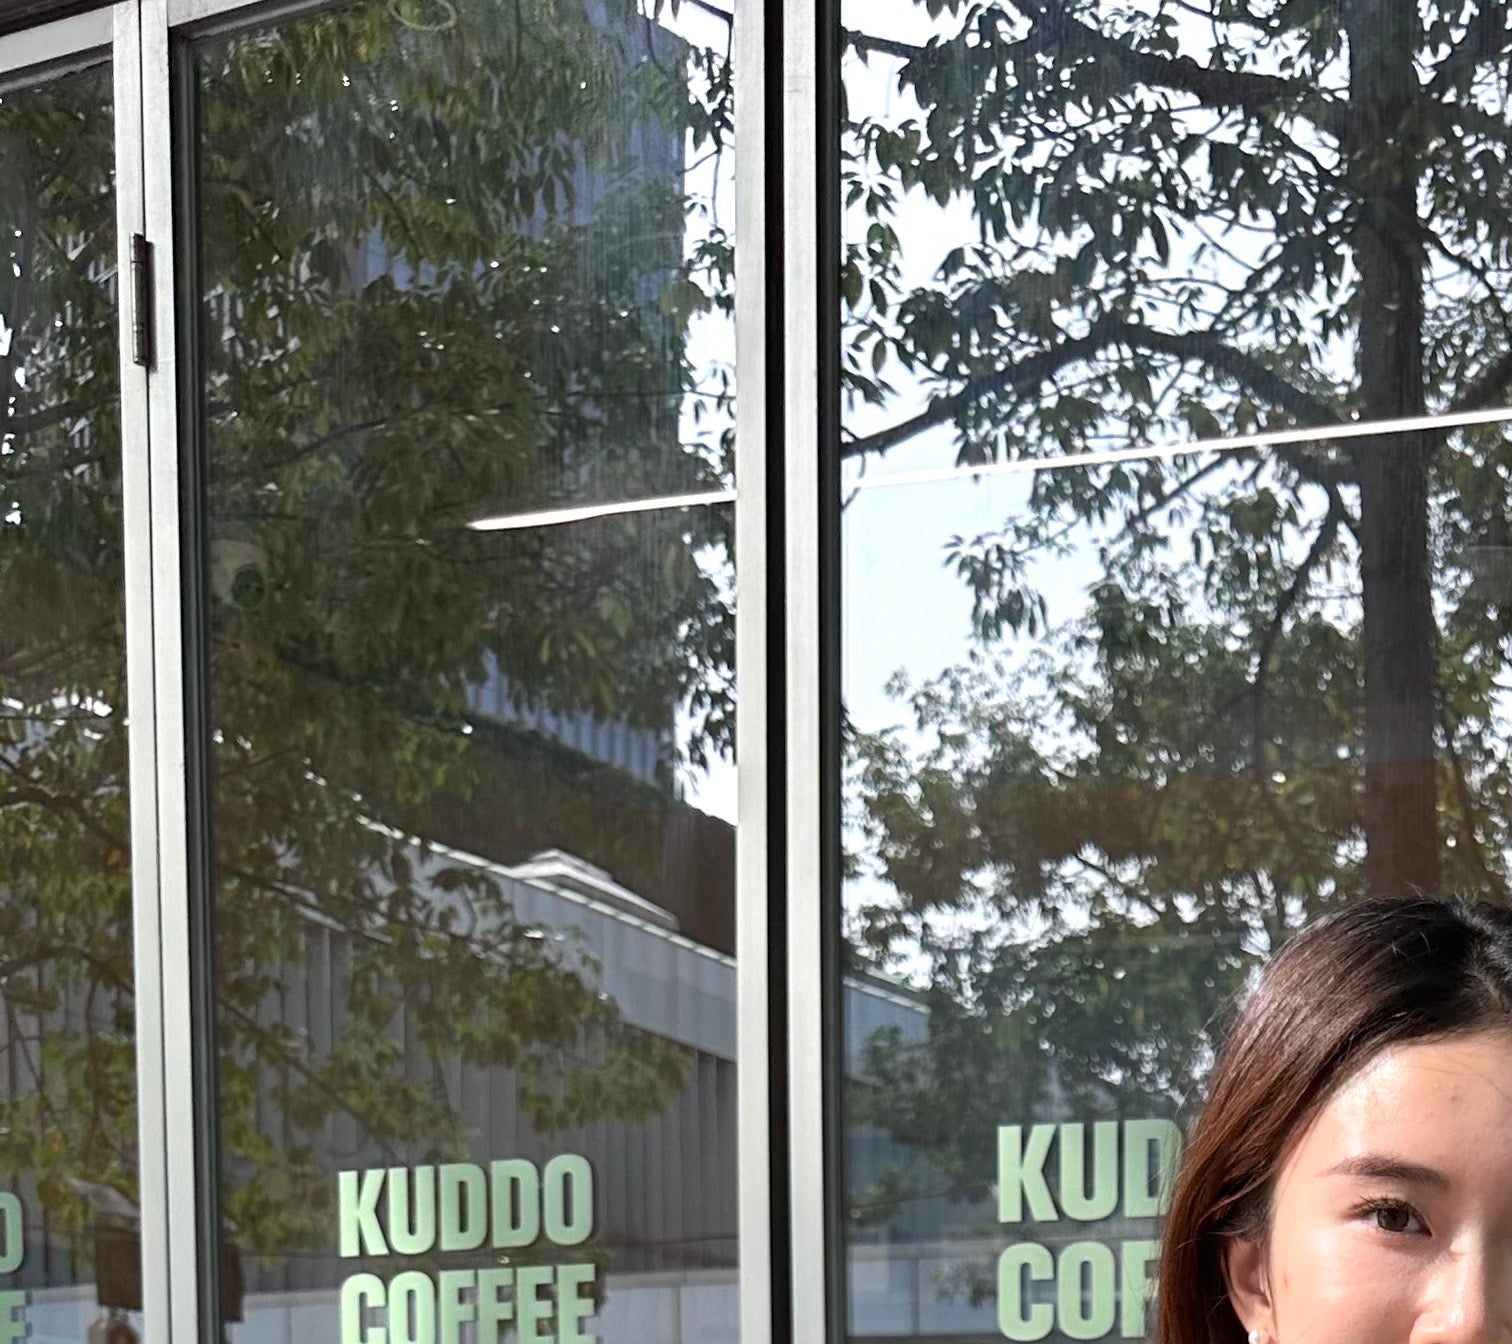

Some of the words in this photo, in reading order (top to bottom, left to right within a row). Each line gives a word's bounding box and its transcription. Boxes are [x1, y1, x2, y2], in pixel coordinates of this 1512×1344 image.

[338, 1154, 592, 1257] KUDDO
[995, 1118, 1182, 1222] KUD
[997, 1238, 1161, 1341] COF
